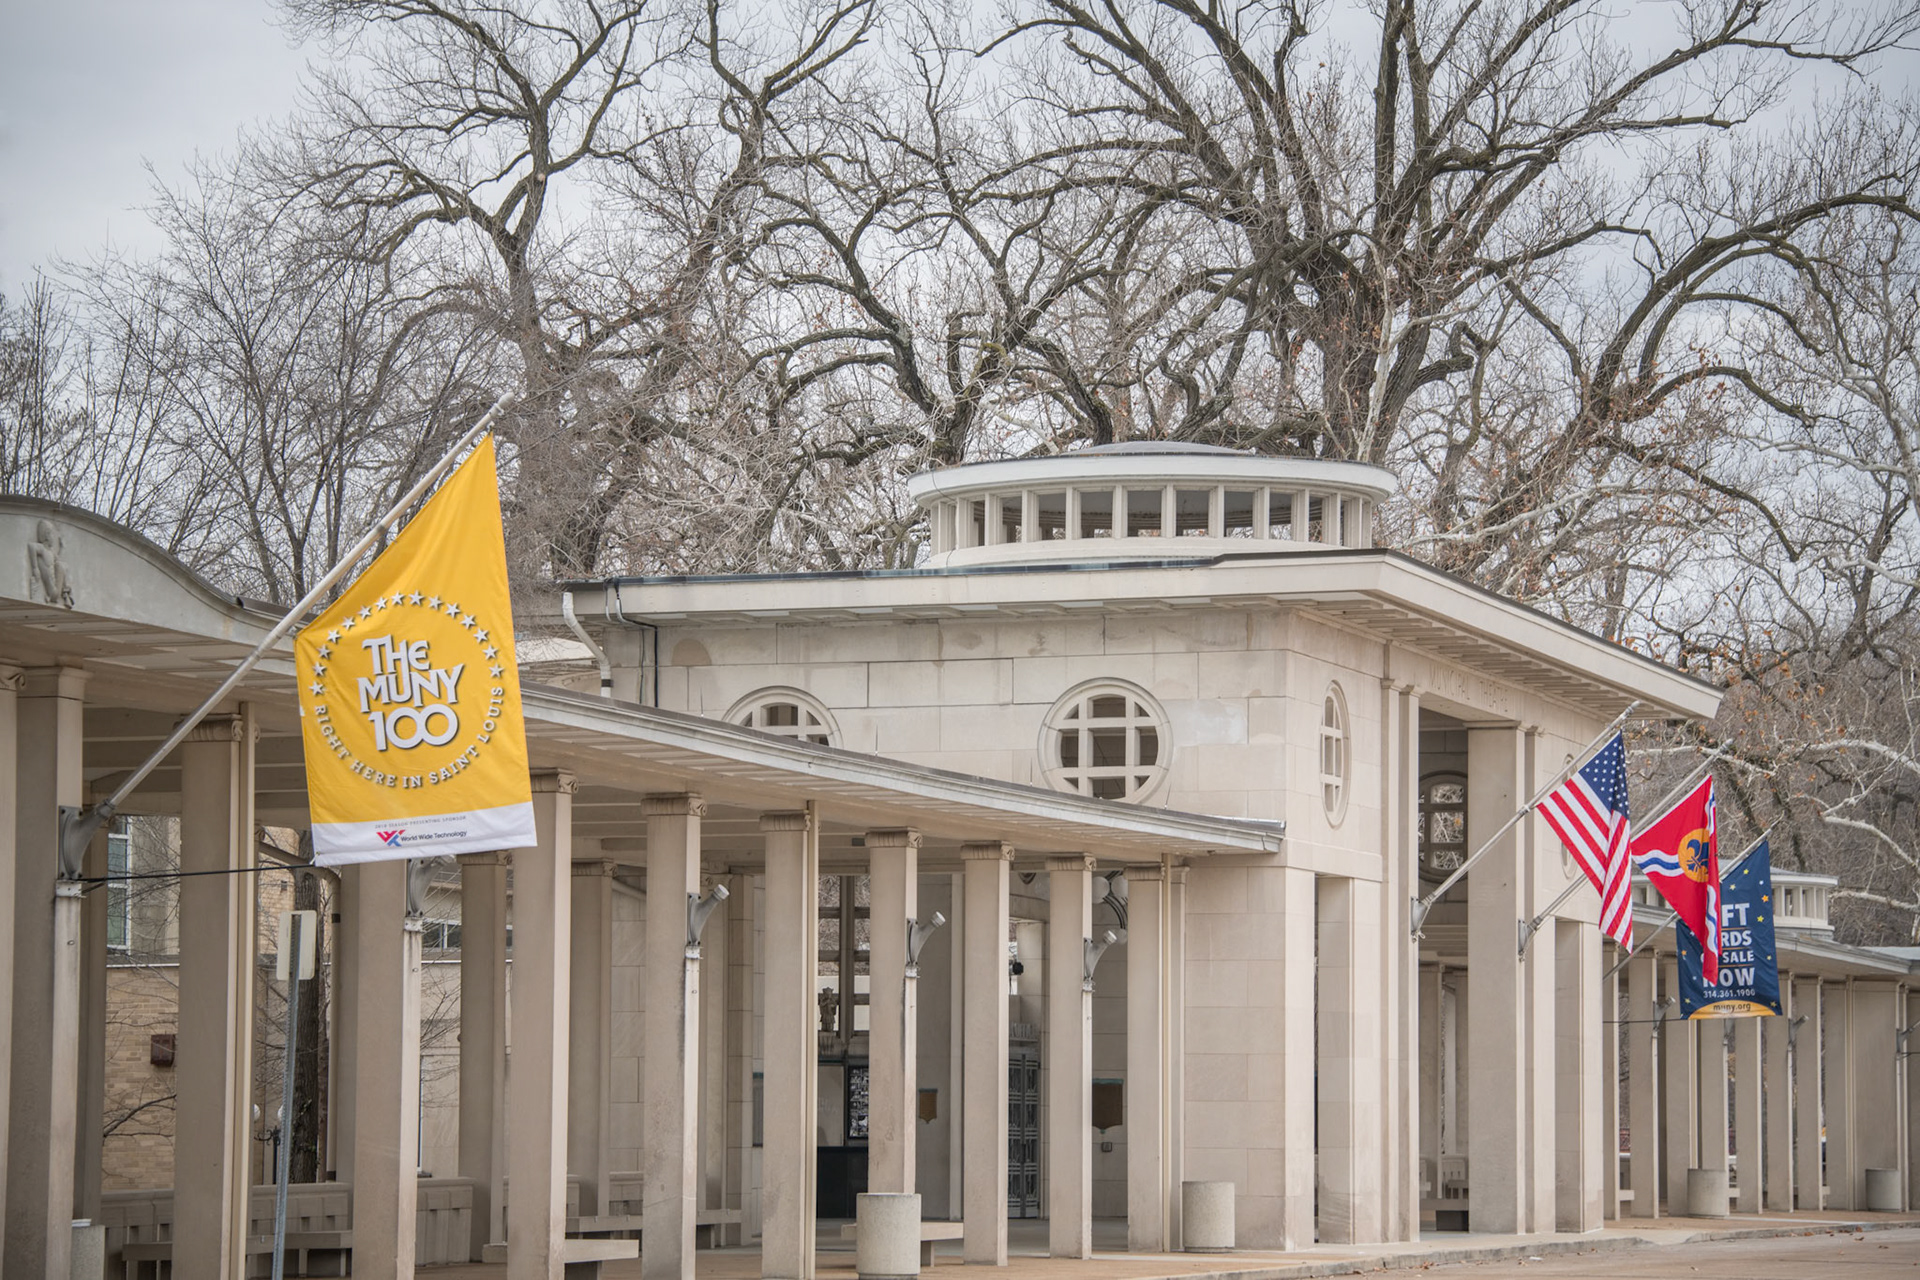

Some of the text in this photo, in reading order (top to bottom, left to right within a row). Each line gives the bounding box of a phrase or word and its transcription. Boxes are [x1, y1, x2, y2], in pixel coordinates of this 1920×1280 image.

[361, 633, 431, 676] THE
[356, 662, 466, 714] MUNY
[314, 686, 504, 788] RIGHT HERE IN SAINT LOUIS
[367, 703, 459, 751] 100
[1721, 903, 1750, 926] FT
[1721, 930, 1753, 947] RDS
[1722, 950, 1755, 964] SALE
[1703, 988, 1756, 999] 314.361.1900
[1713, 1002, 1752, 1012] muny.org
